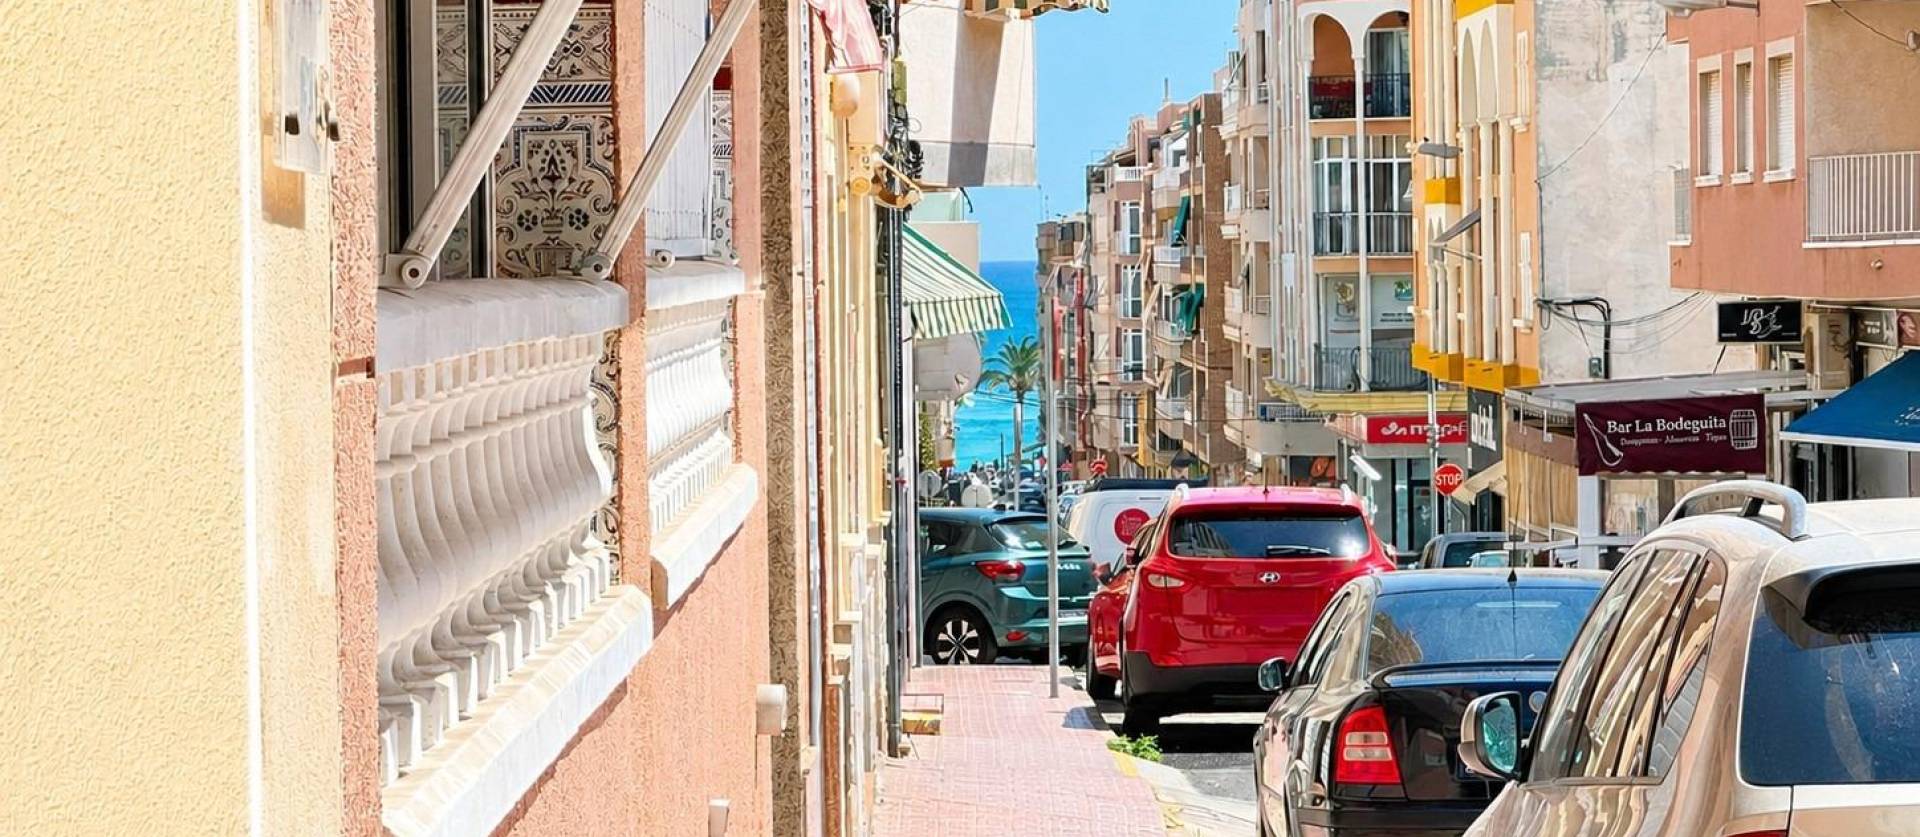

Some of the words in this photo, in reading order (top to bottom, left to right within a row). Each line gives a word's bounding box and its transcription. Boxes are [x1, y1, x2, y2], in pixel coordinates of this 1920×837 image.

[1606, 420, 1632, 433] Bar
[1634, 419, 1653, 432] La
[1656, 416, 1727, 433] Bodeguita
[1435, 473, 1462, 487] STOP
